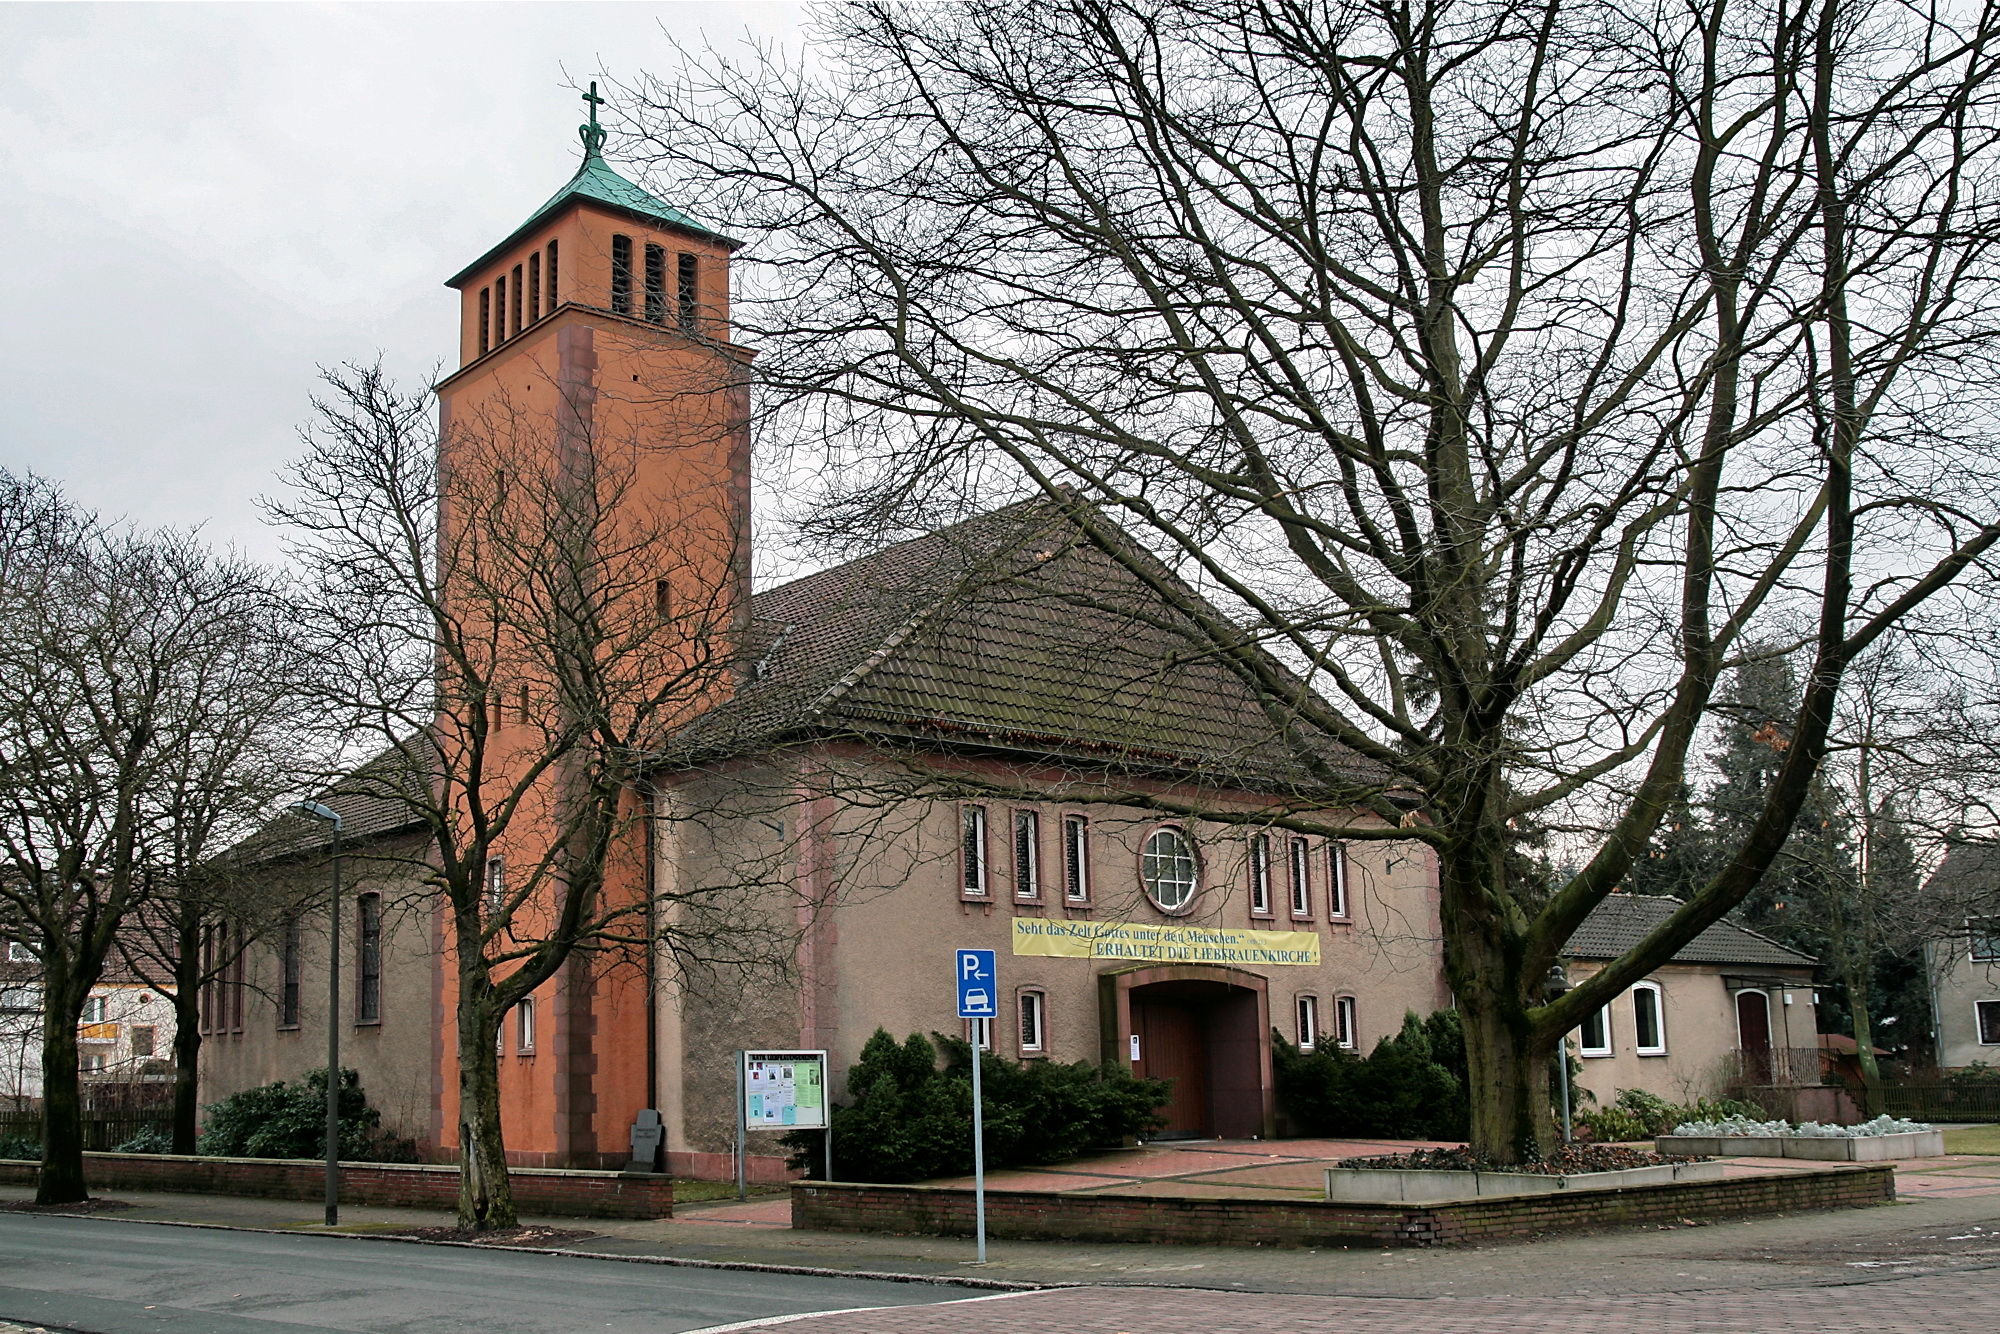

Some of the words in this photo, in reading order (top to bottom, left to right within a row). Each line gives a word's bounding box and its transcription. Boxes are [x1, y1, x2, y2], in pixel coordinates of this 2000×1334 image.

[1017, 921, 1043, 935] Seht
[1046, 923, 1065, 936] das
[1068, 924, 1091, 938] Zelt
[1095, 925, 1130, 939] Gottes
[1133, 930, 1161, 941] unter
[1164, 930, 1184, 943] den
[1096, 943, 1165, 960] ERHALTET
[1168, 947, 1190, 959] DIE
[963, 954, 979, 980] P
